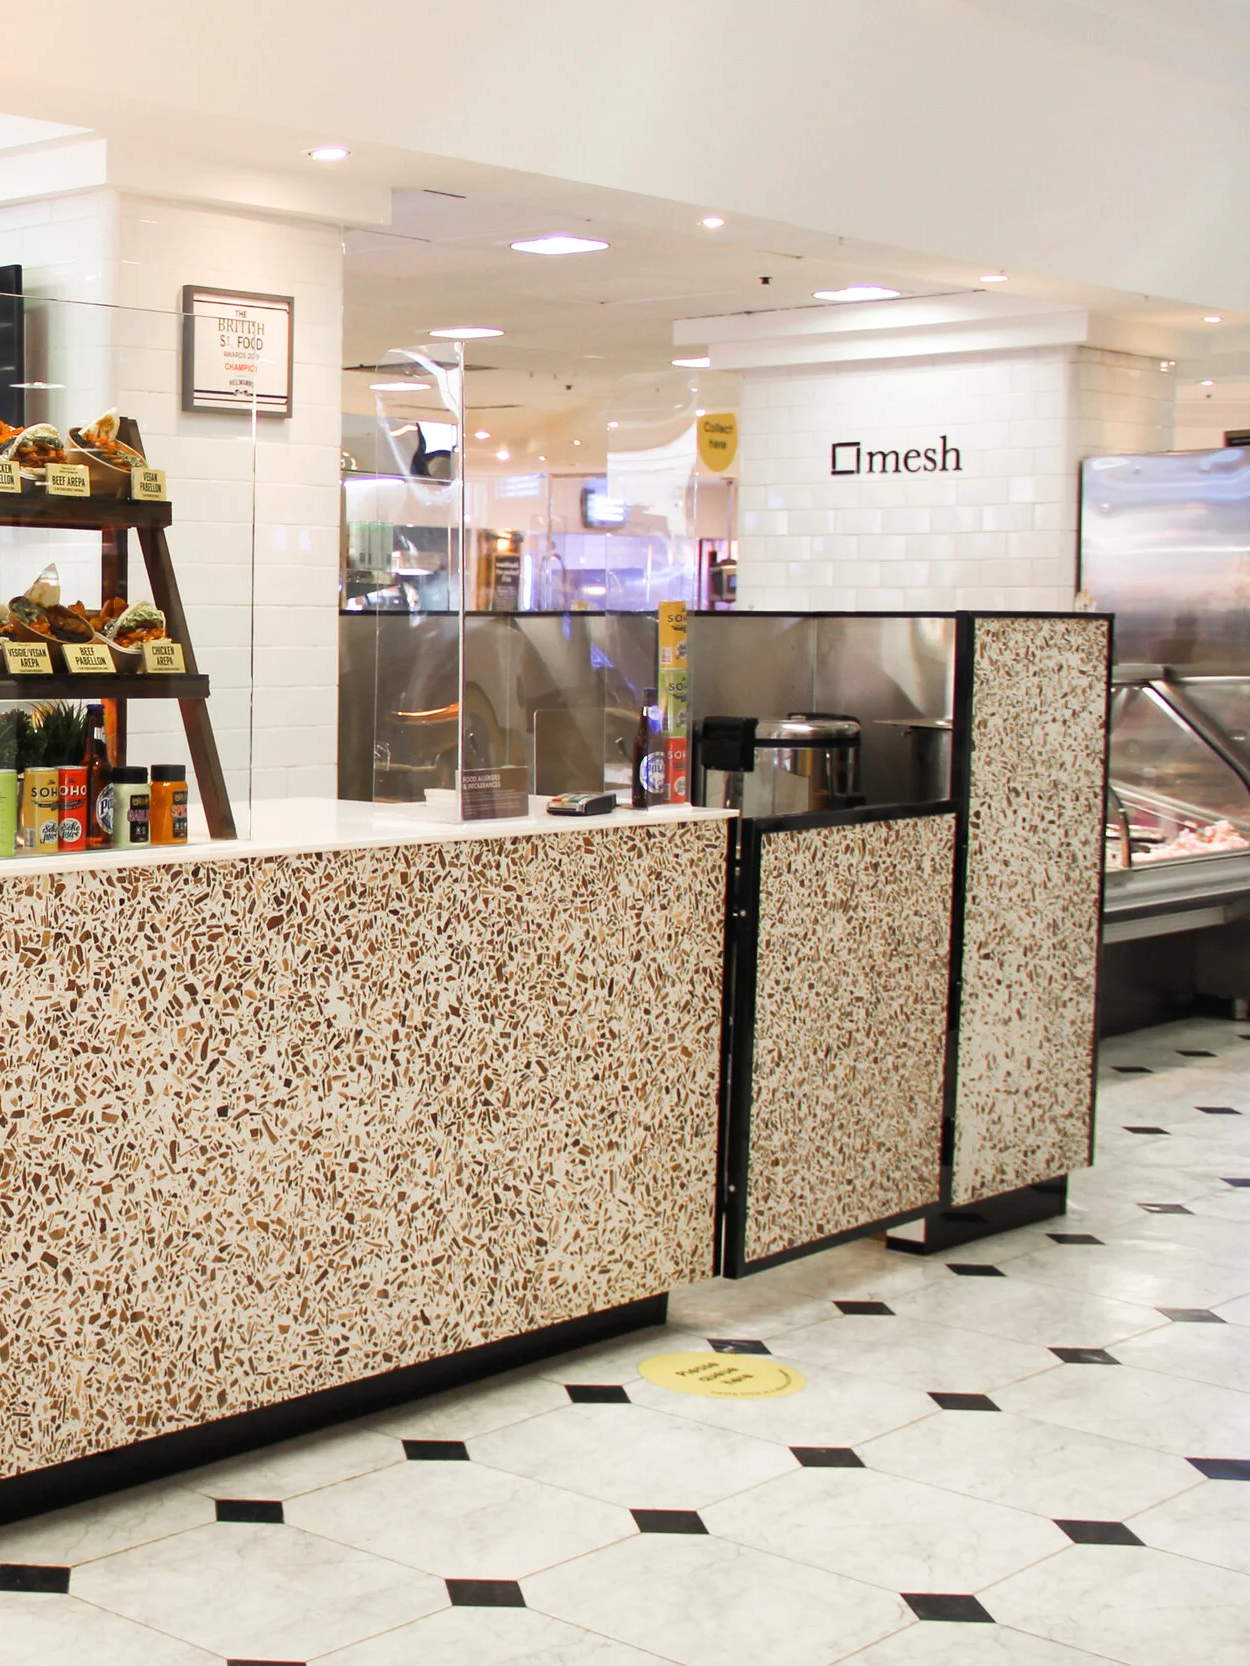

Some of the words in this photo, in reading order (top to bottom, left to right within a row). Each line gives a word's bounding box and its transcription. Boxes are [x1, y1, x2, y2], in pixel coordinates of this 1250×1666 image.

[235, 310, 247, 318] THE
[703, 421, 734, 435] Collect
[708, 438, 727, 450] here
[866, 435, 963, 474] mesh
[52, 475, 66, 486] BEEF
[67, 476, 86, 488] AREPA
[143, 471, 158, 482] VEGAN
[139, 482, 162, 494] PABELLON
[8, 648, 47, 658] VEGGIE/VEGAN
[79, 646, 95, 656] BEEF
[151, 645, 175, 656] CHICKEN
[20, 656, 40, 668] AREPA
[75, 655, 107, 667] PABELLON
[156, 655, 174, 666] AREPA
[31, 786, 58, 799] SOH
[59, 785, 87, 796] OHO
